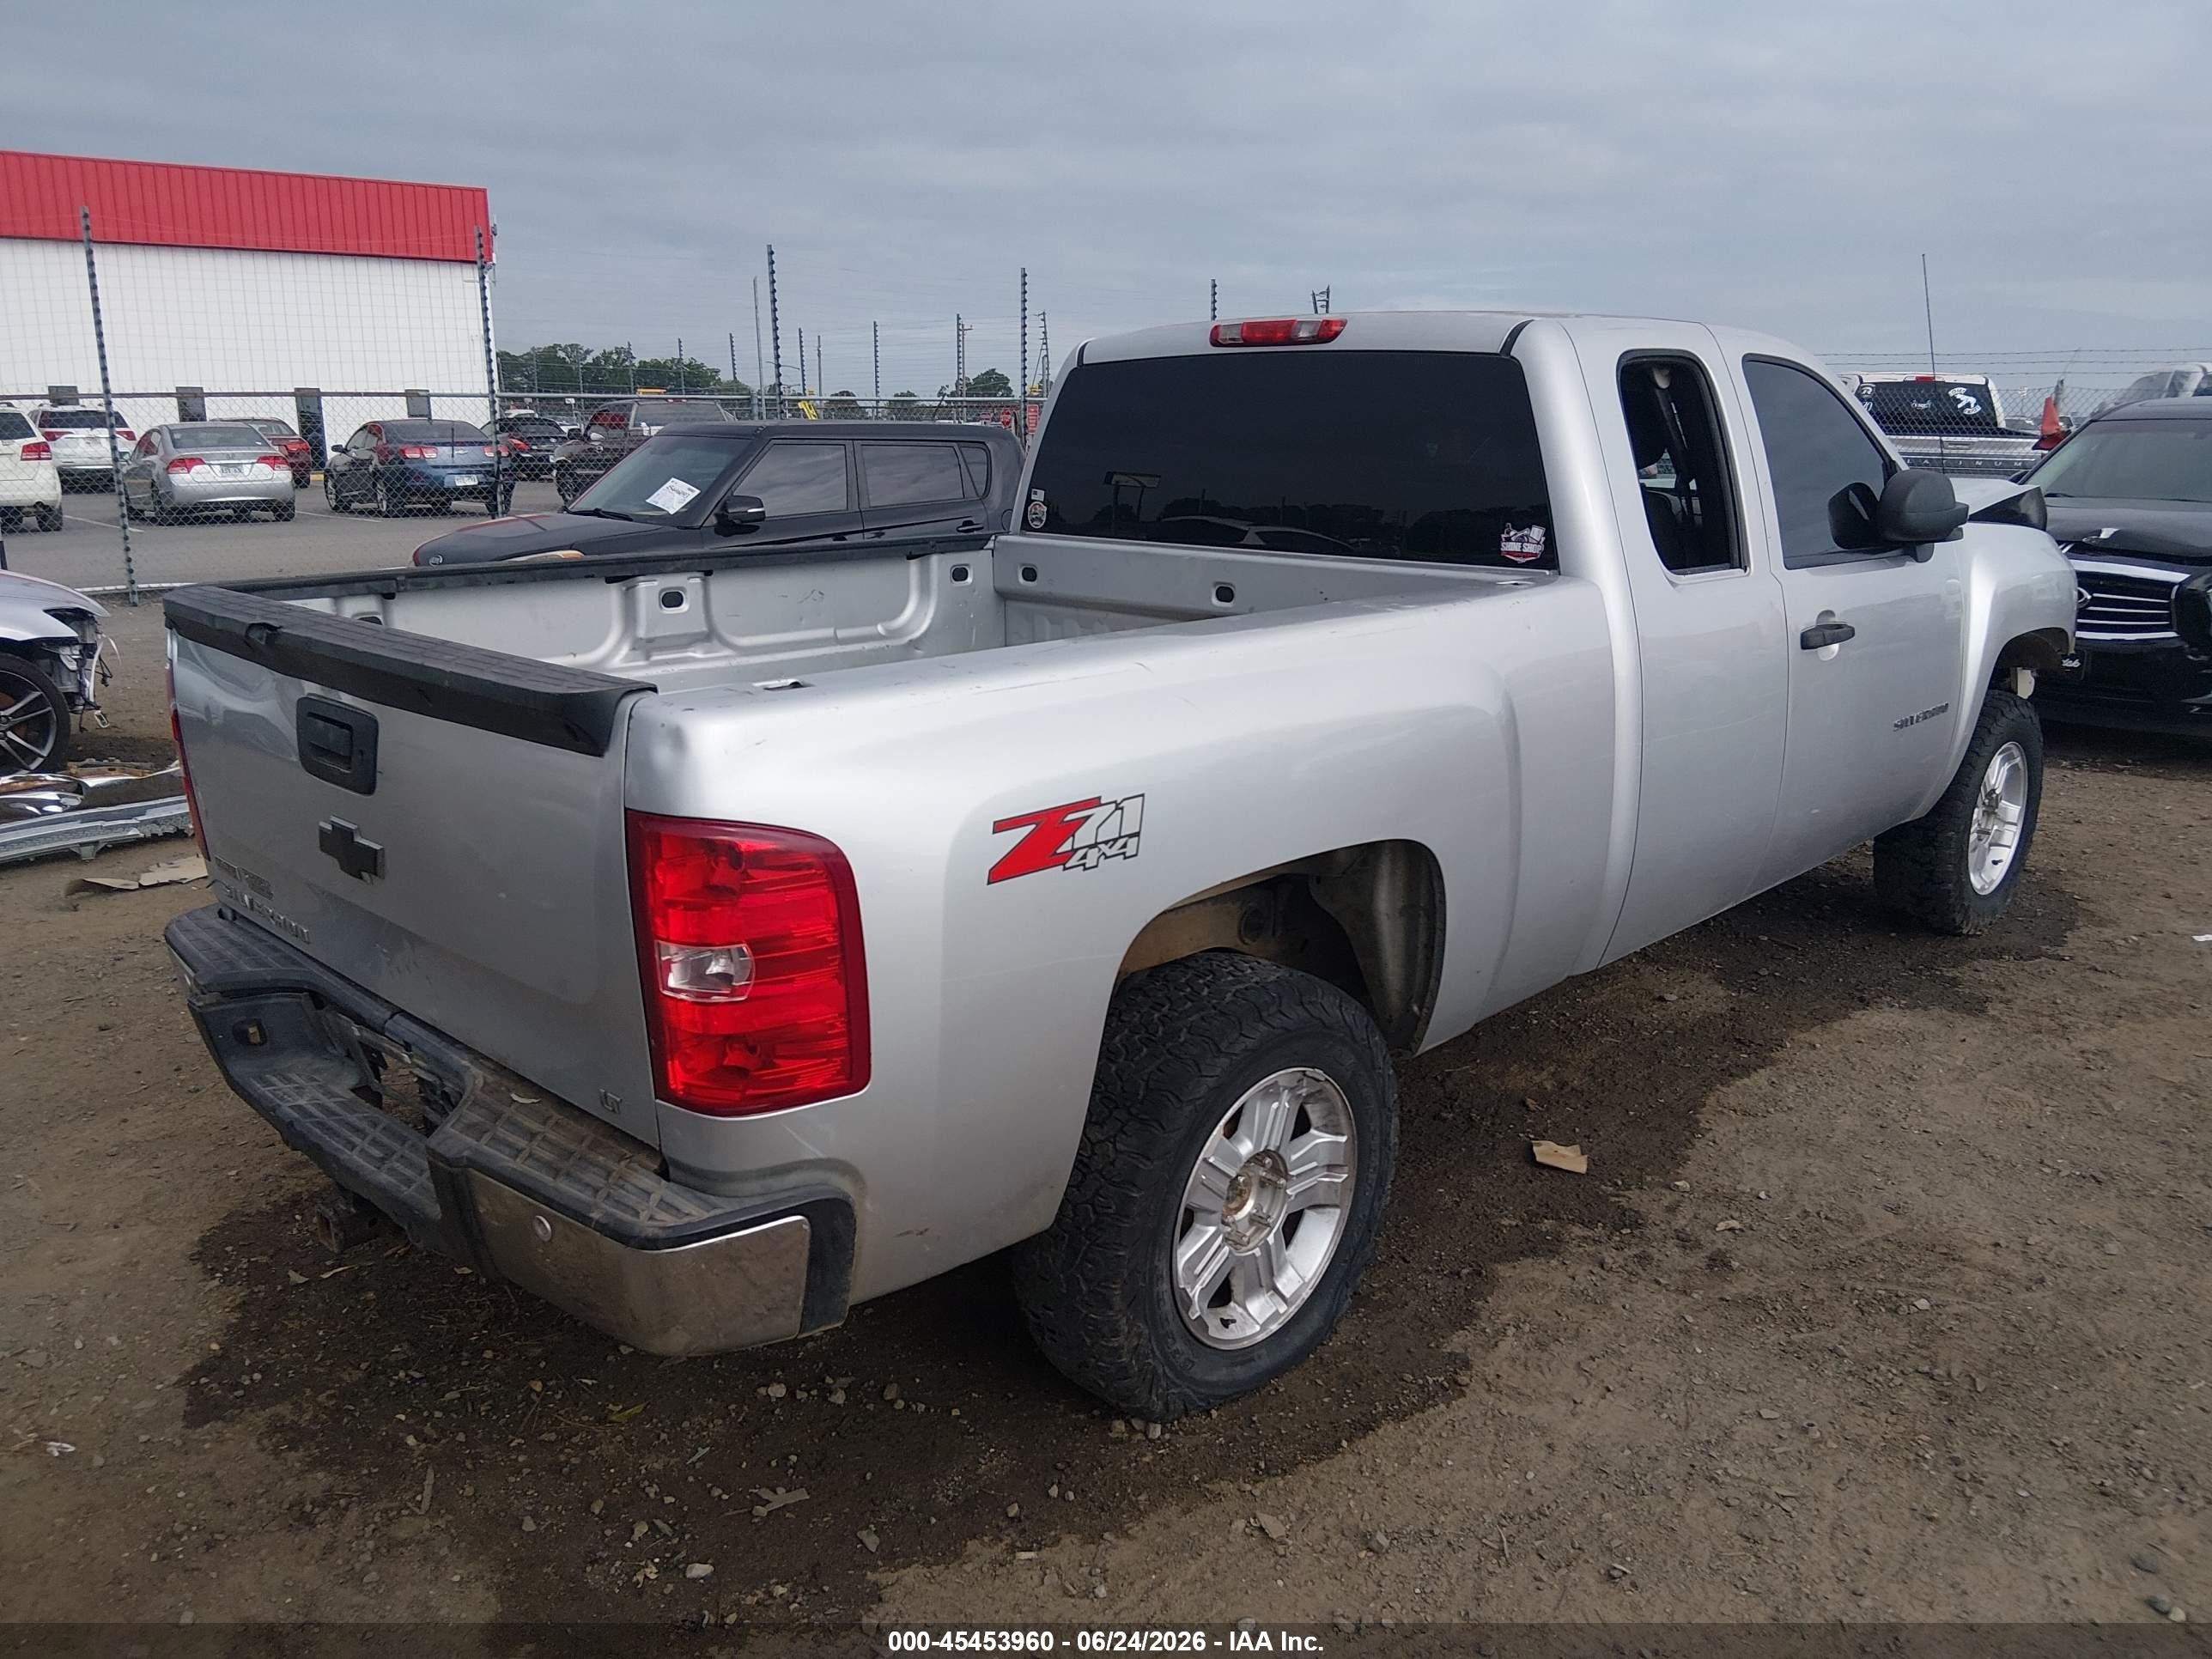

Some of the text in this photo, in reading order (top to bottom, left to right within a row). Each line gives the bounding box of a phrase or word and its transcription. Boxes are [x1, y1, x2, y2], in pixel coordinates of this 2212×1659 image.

[1906, 459, 2023, 467] LATINUM
[1522, 543, 1542, 554] SHOP
[987, 793, 1145, 885] Z71
[599, 1088, 622, 1115] LT
